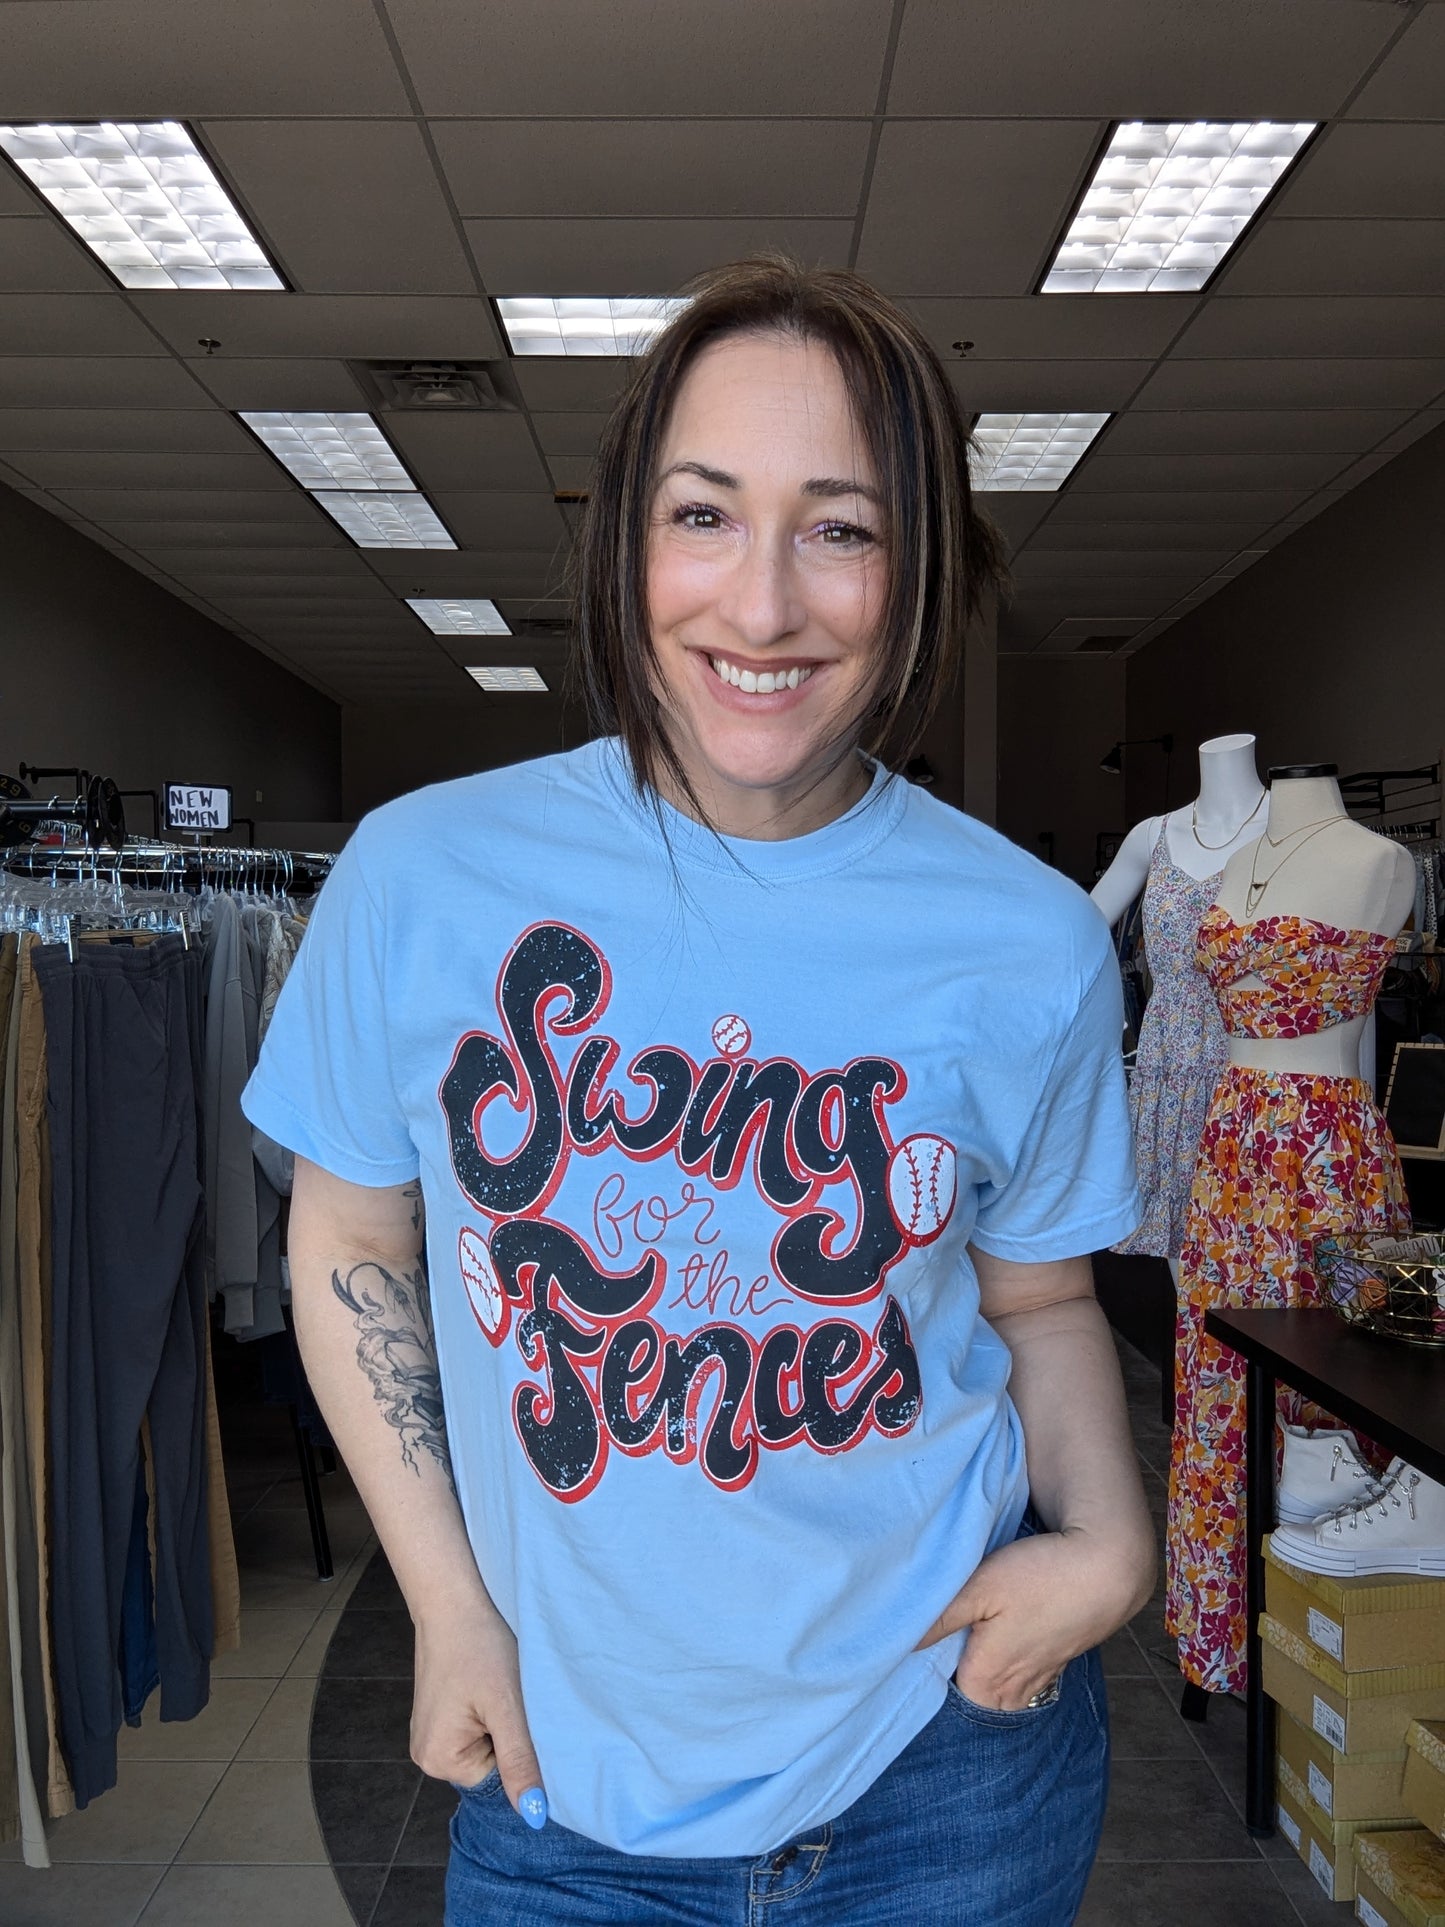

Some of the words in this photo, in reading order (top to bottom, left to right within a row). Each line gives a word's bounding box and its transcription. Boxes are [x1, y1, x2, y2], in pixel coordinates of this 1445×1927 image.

[169, 807, 220, 828] WOMEN
[170, 789, 213, 808] NEW
[439, 920, 908, 1307] Swing
[593, 1173, 722, 1259] for
[668, 1250, 794, 1316] the
[489, 1216, 923, 1504] Fences
